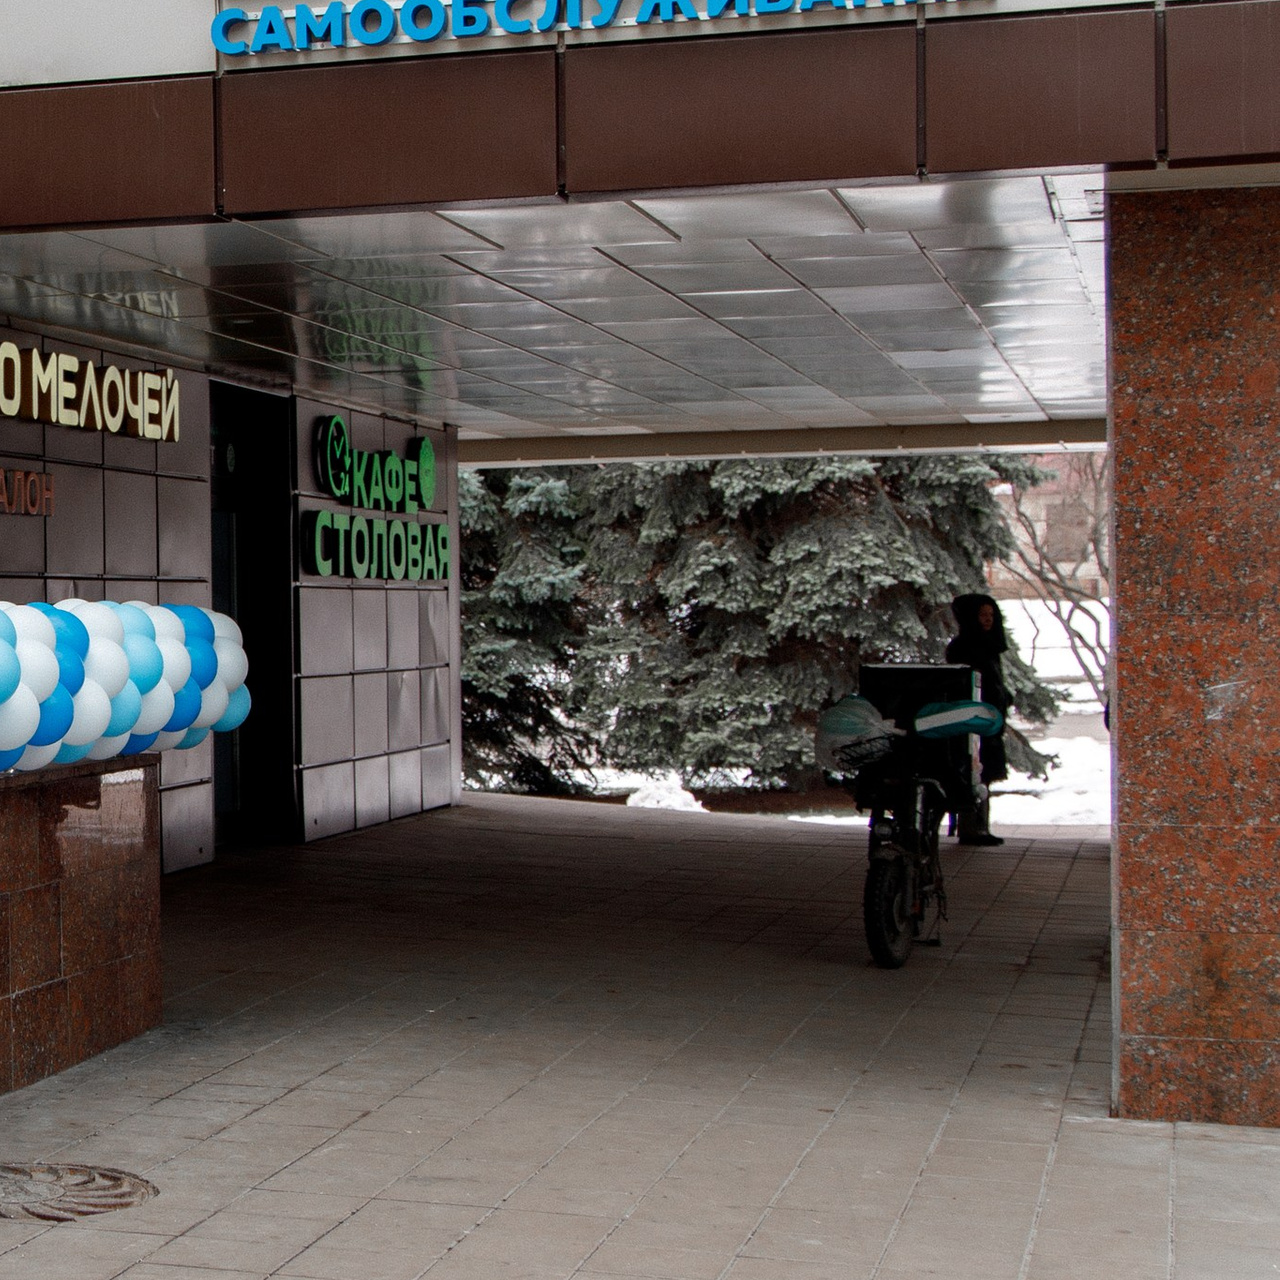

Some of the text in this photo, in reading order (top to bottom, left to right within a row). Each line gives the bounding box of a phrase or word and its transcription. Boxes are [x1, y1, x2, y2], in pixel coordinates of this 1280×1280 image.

[32, 347, 180, 443] МЕЛОЧЕЙ
[339, 472, 350, 496] 24
[353, 449, 419, 515] КАФЕ
[315, 510, 449, 581] СТОЛОВАЯ
